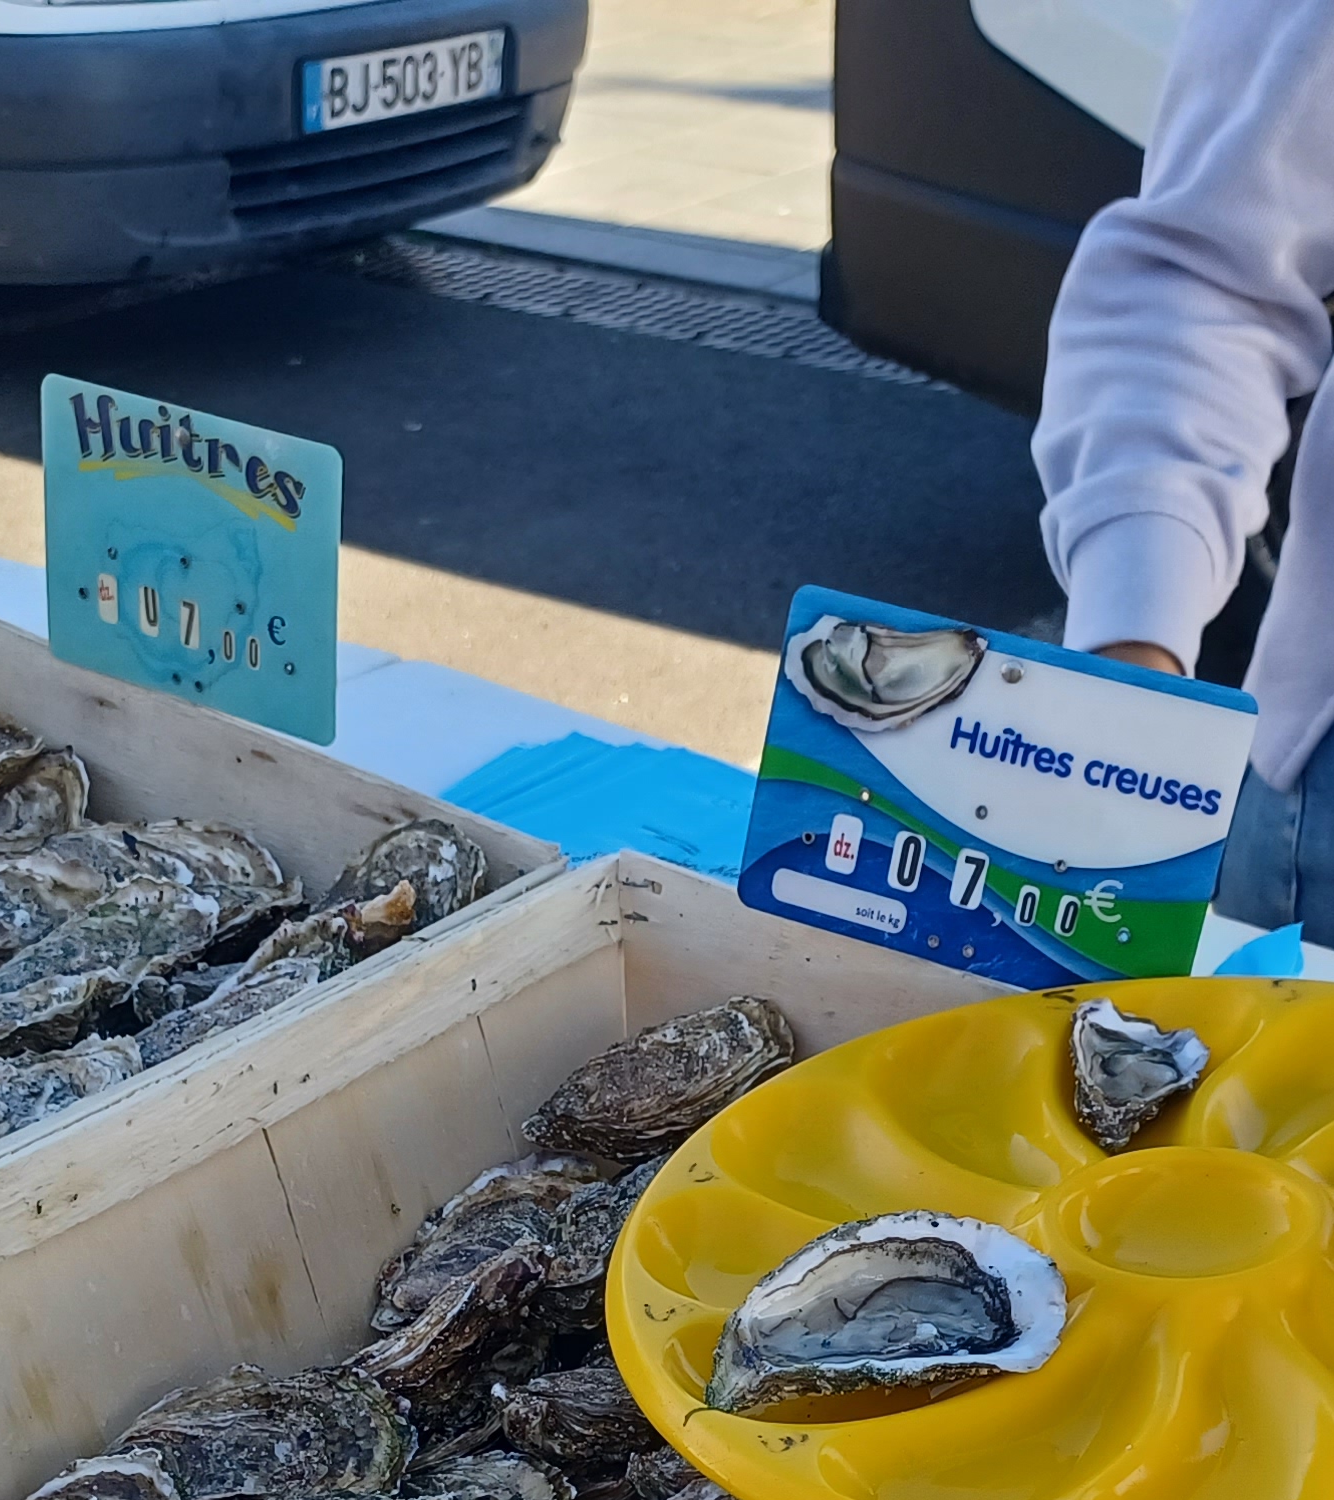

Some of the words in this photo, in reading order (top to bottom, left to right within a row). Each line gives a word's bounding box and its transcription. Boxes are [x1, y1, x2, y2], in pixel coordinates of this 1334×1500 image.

[329, 42, 484, 119] BJ-503-YB
[69, 392, 306, 519] Huitres
[949, 716, 1076, 779] Huîtres
[1083, 758, 1222, 815] creuses
[832, 832, 856, 862] dz.
[855, 903, 876, 922] soit
[876, 908, 887, 924] le
[887, 912, 902, 931] kg
